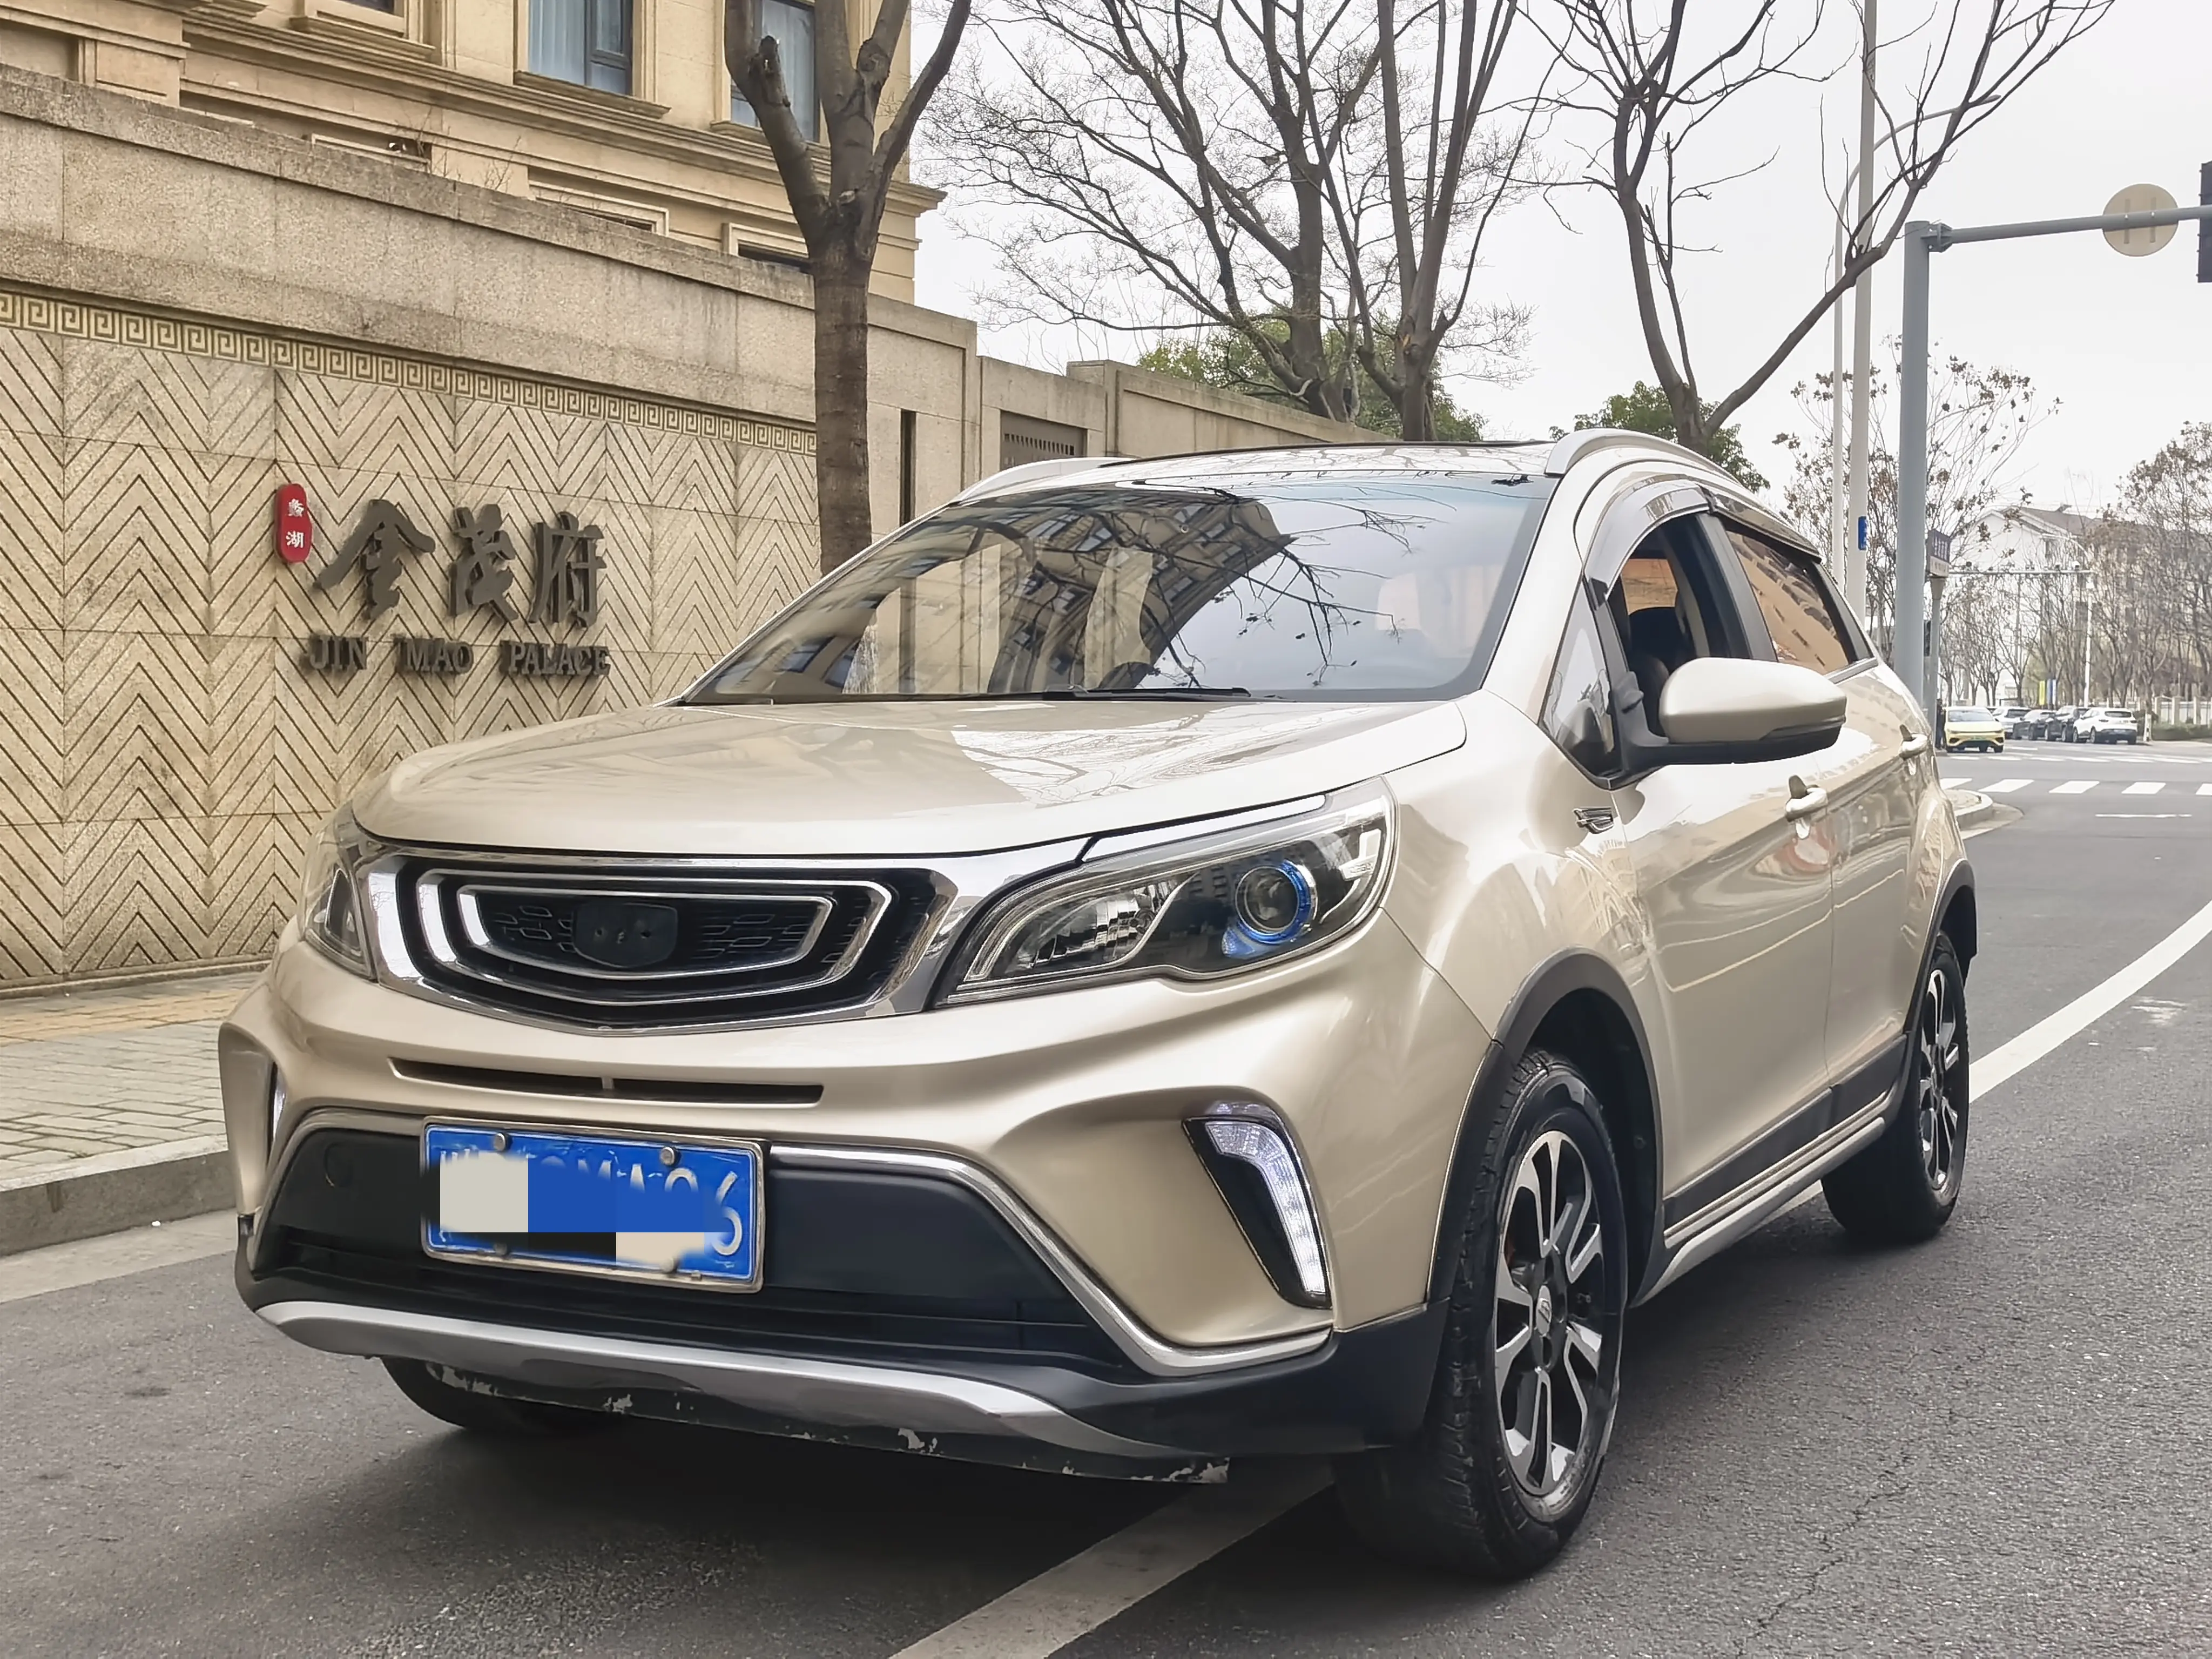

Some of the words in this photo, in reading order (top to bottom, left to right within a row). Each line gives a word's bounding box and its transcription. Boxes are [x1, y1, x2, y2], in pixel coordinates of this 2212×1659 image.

[313, 500, 606, 628] 金茂府
[309, 635, 366, 670] JIN
[402, 638, 474, 673] MAO
[507, 642, 610, 675] PALACE
